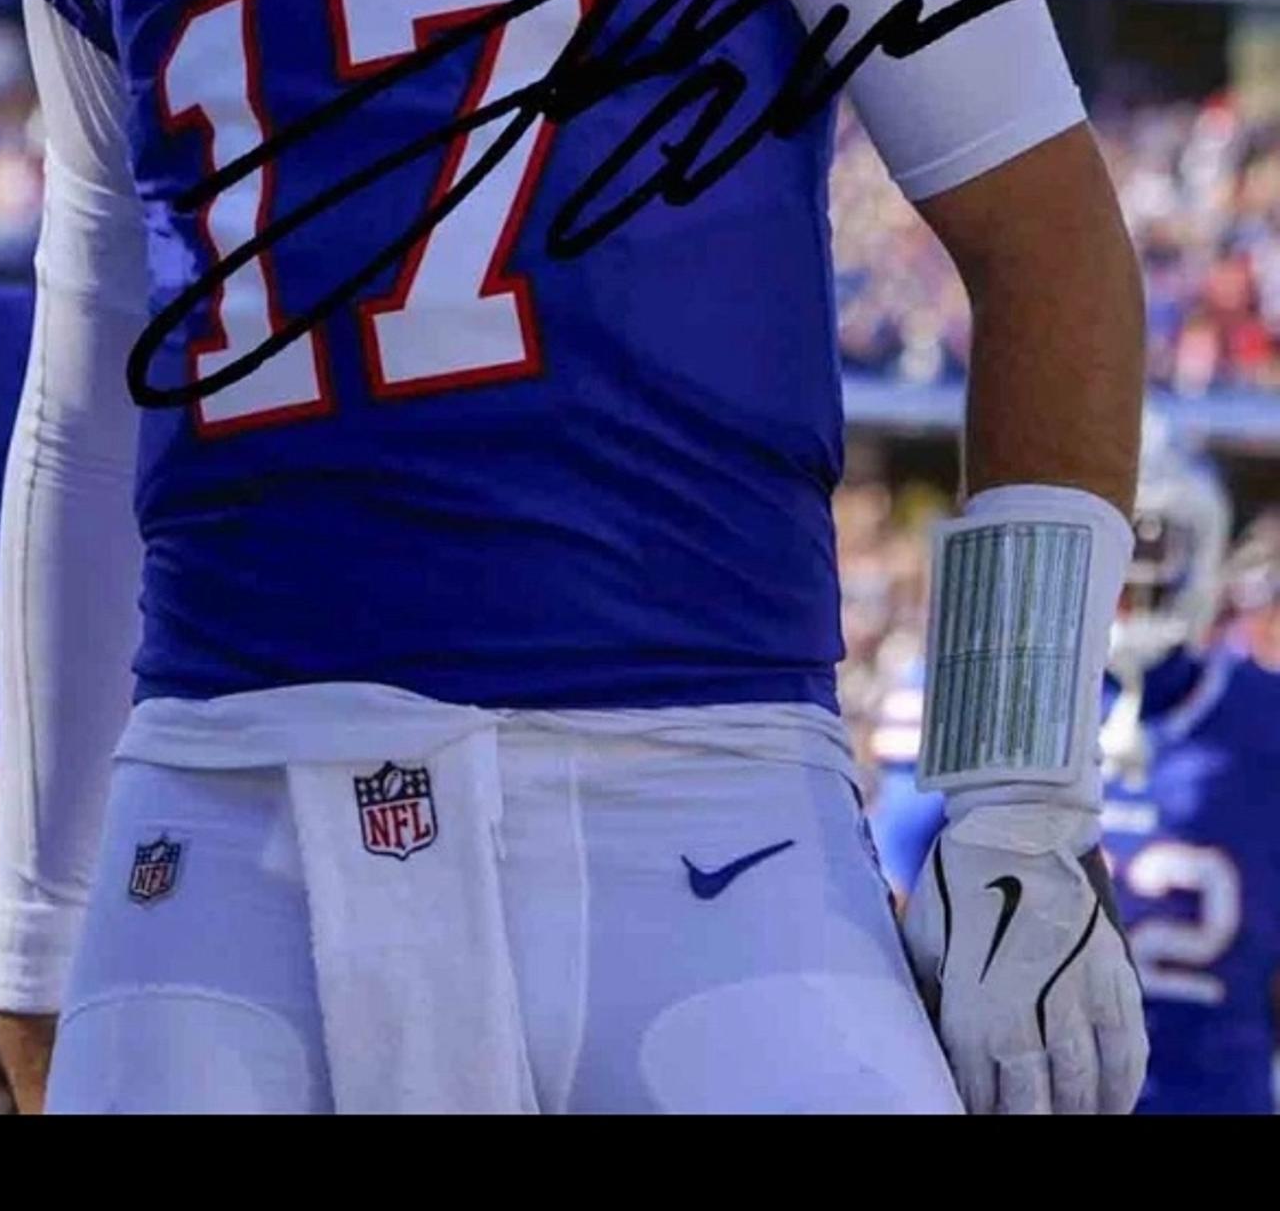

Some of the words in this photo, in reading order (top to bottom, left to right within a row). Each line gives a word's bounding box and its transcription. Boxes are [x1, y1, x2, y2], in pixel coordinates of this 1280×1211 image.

[365, 801, 432, 851] NFL
[132, 865, 170, 893] NFL
[1100, 841, 1241, 1005] 2
